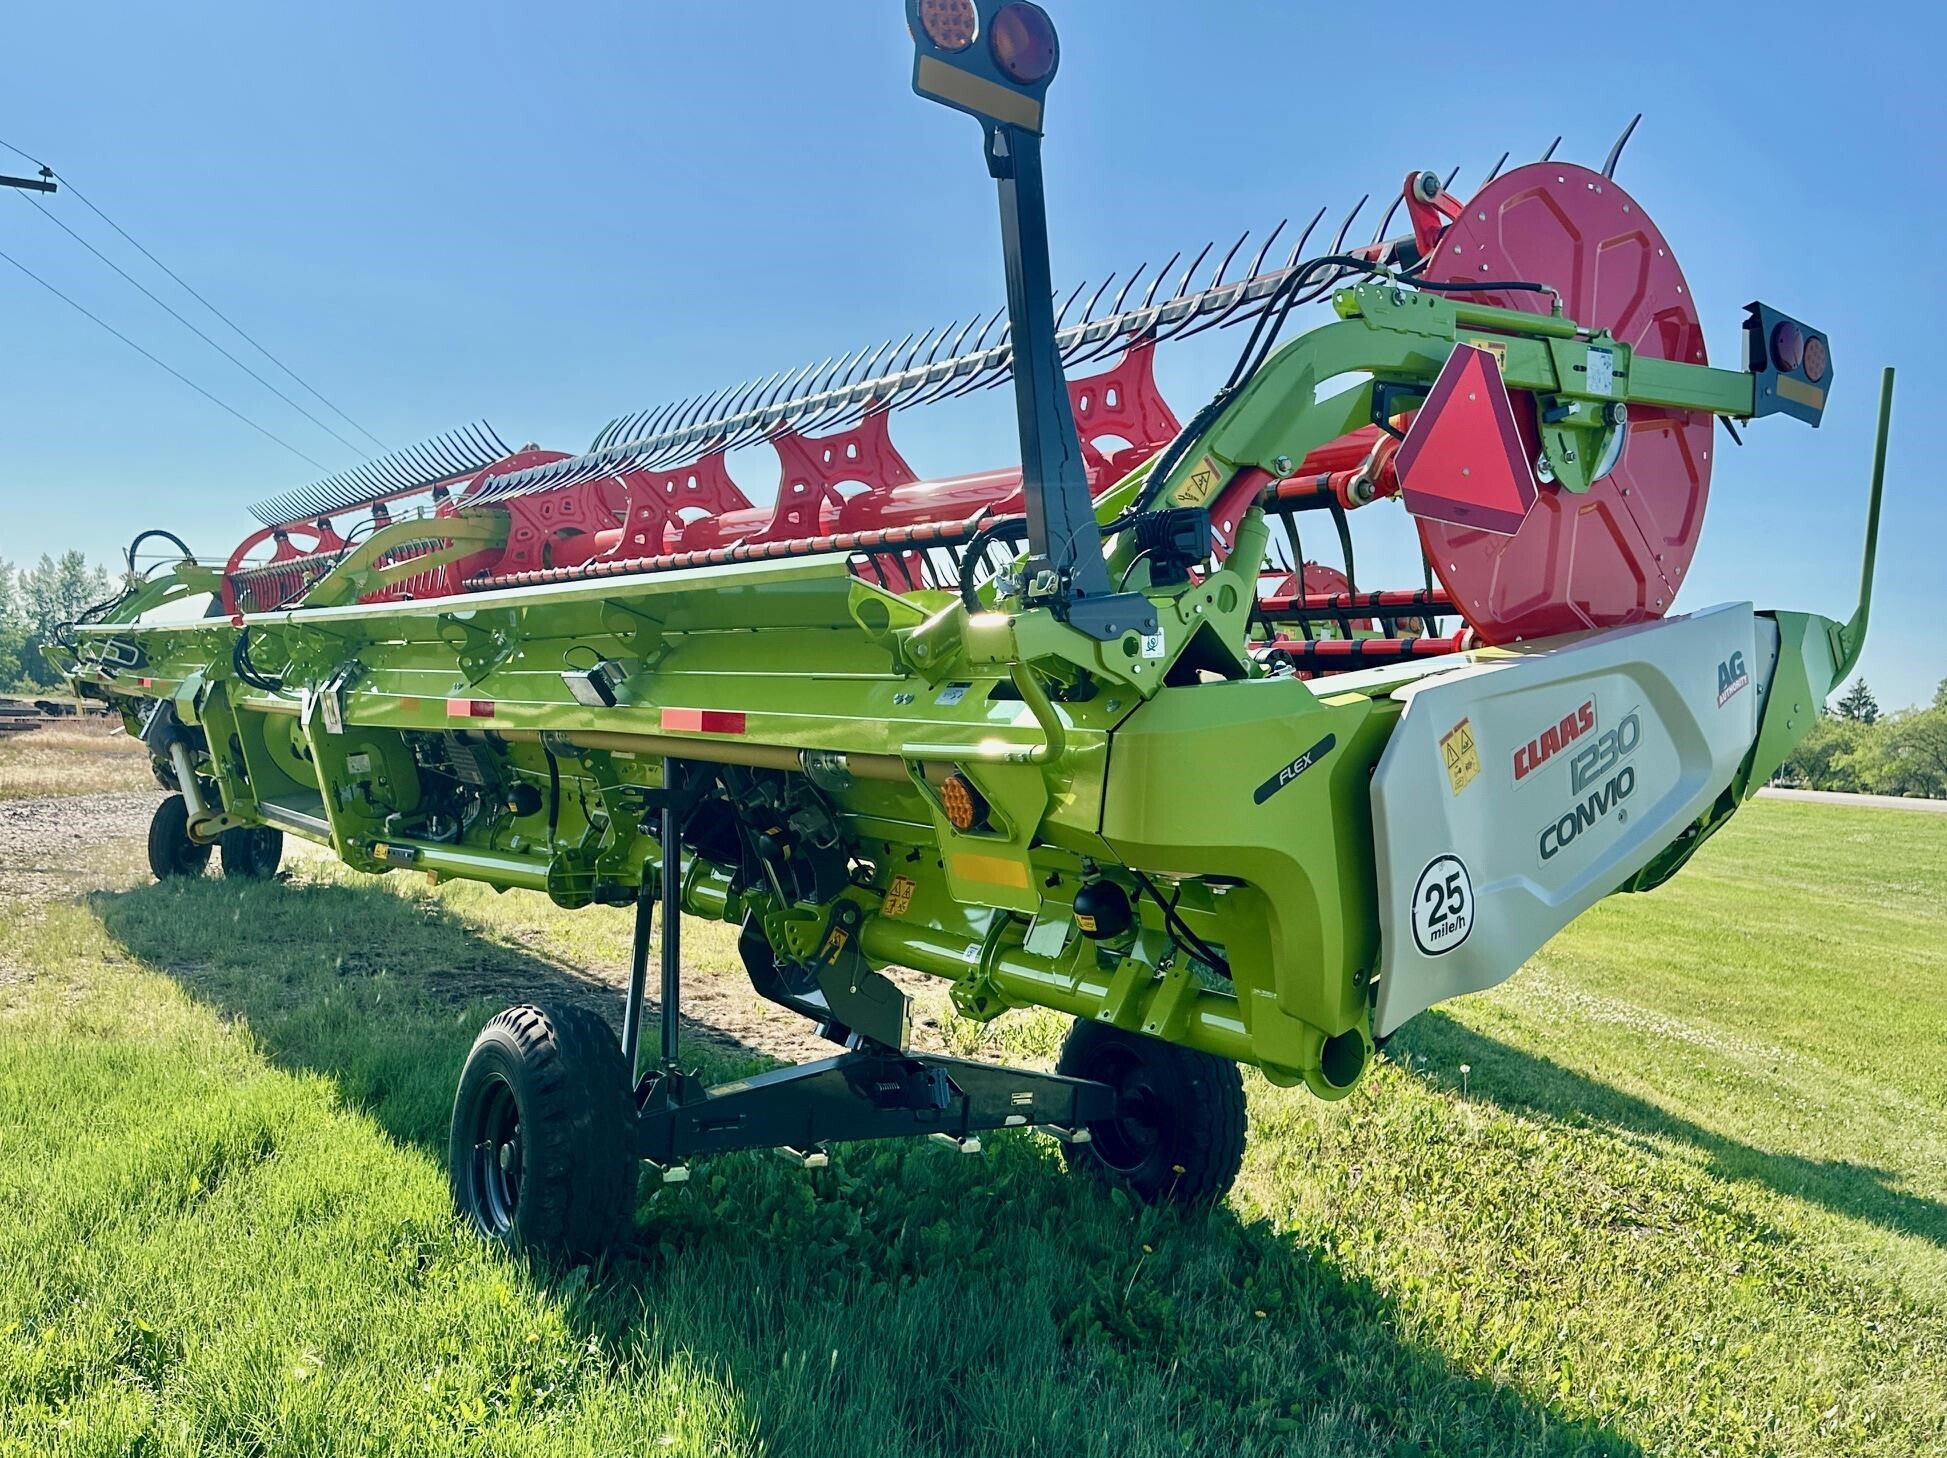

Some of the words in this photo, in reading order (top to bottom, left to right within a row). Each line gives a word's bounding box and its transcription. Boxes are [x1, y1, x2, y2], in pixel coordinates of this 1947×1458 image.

[1718, 650, 1745, 695] AG
[1719, 674, 1748, 705] AUTHORITY
[1514, 701, 1594, 780] CLAAS
[1570, 713, 1640, 796] 1230
[1279, 752, 1312, 786] FLEX
[1540, 766, 1635, 860] CONVIO
[1425, 870, 1464, 928] 25
[1430, 915, 1466, 942] mile/h
